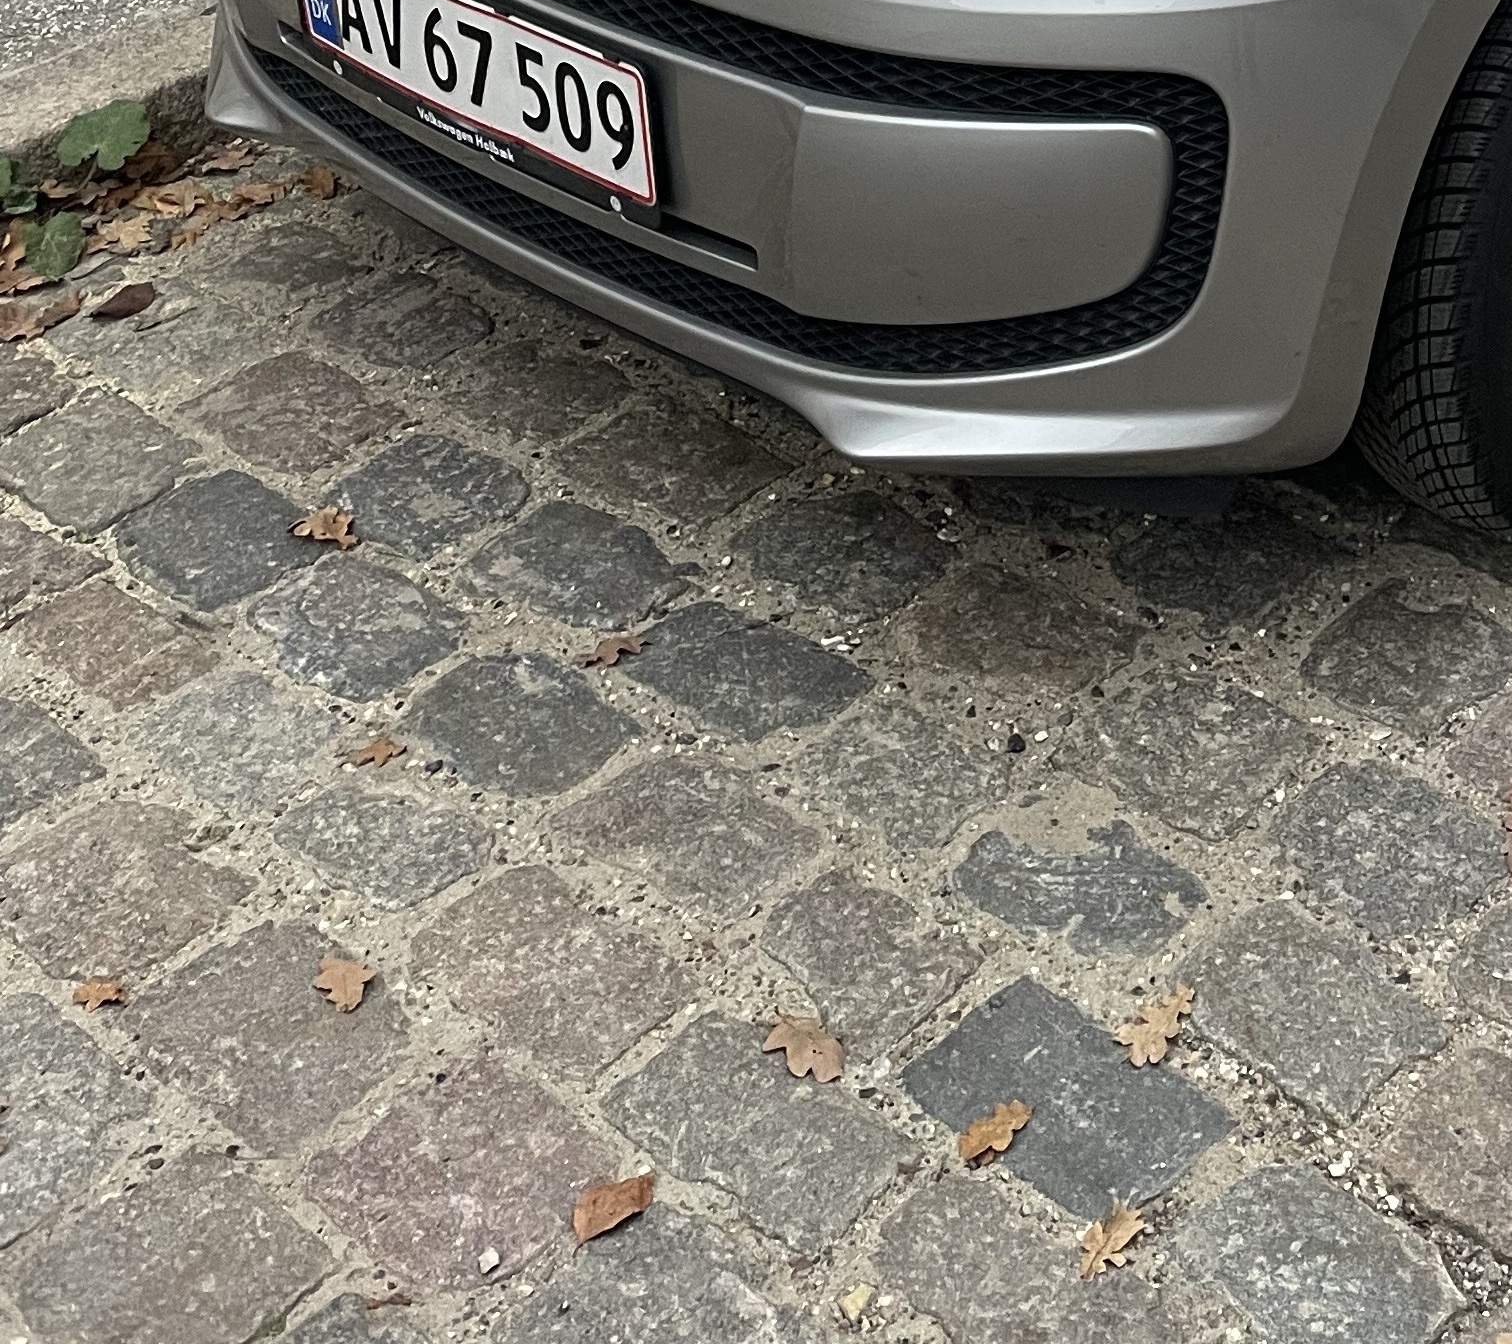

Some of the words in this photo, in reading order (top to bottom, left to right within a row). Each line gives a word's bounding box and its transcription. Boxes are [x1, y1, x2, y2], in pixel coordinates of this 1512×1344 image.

[416, 105, 474, 143] Volkswagen
[423, 7, 492, 107] 67
[515, 41, 635, 171] 509
